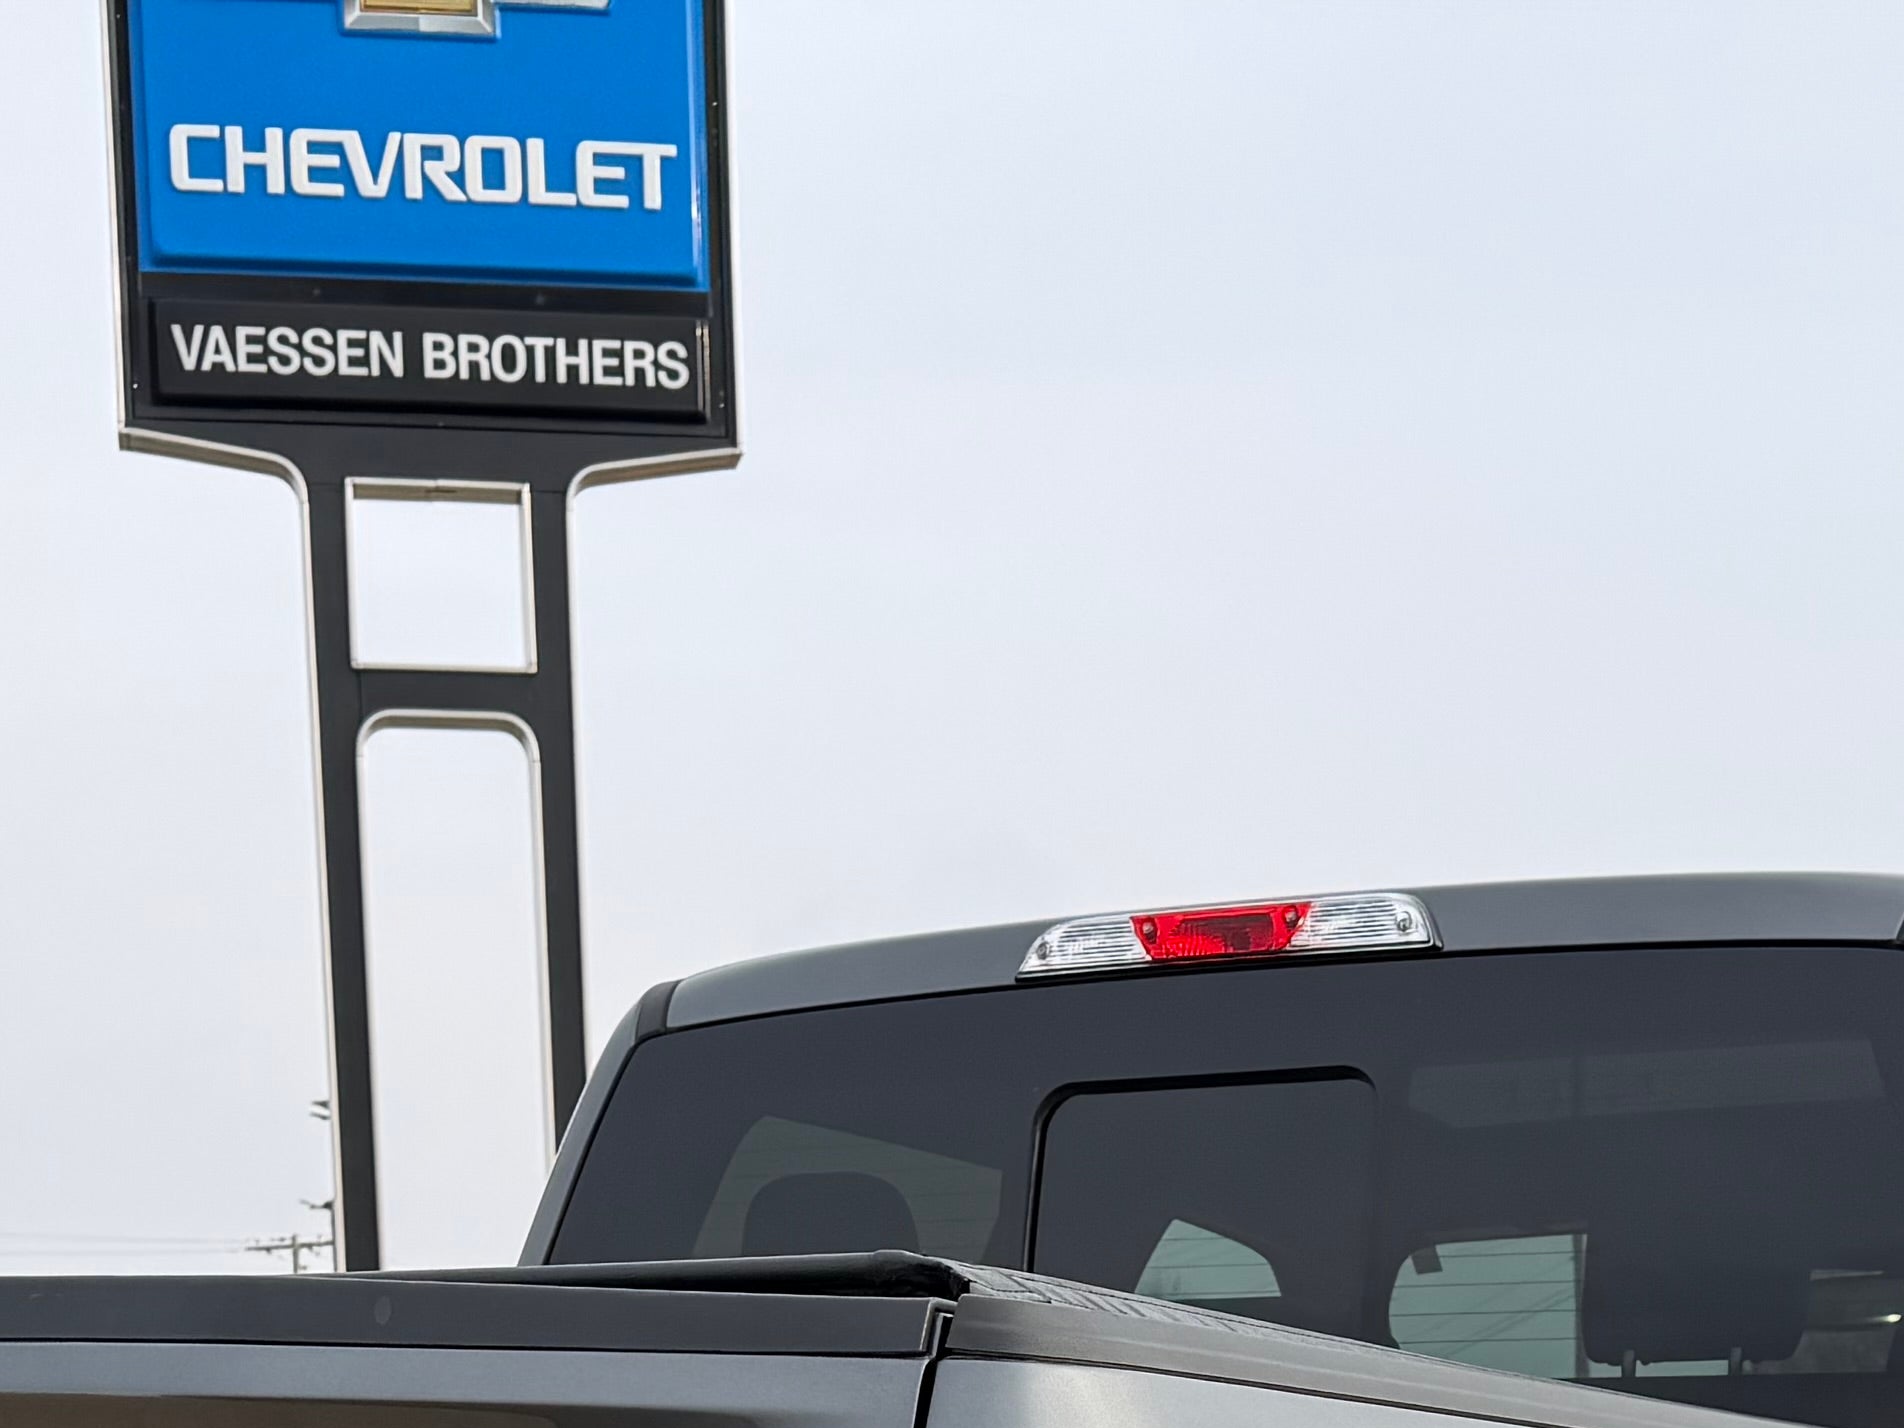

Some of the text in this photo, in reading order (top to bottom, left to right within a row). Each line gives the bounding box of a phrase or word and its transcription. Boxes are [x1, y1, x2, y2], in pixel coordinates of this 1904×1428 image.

[168, 123, 678, 211] CHEVROLET
[170, 323, 690, 391] VAESSEN BROTHERS
